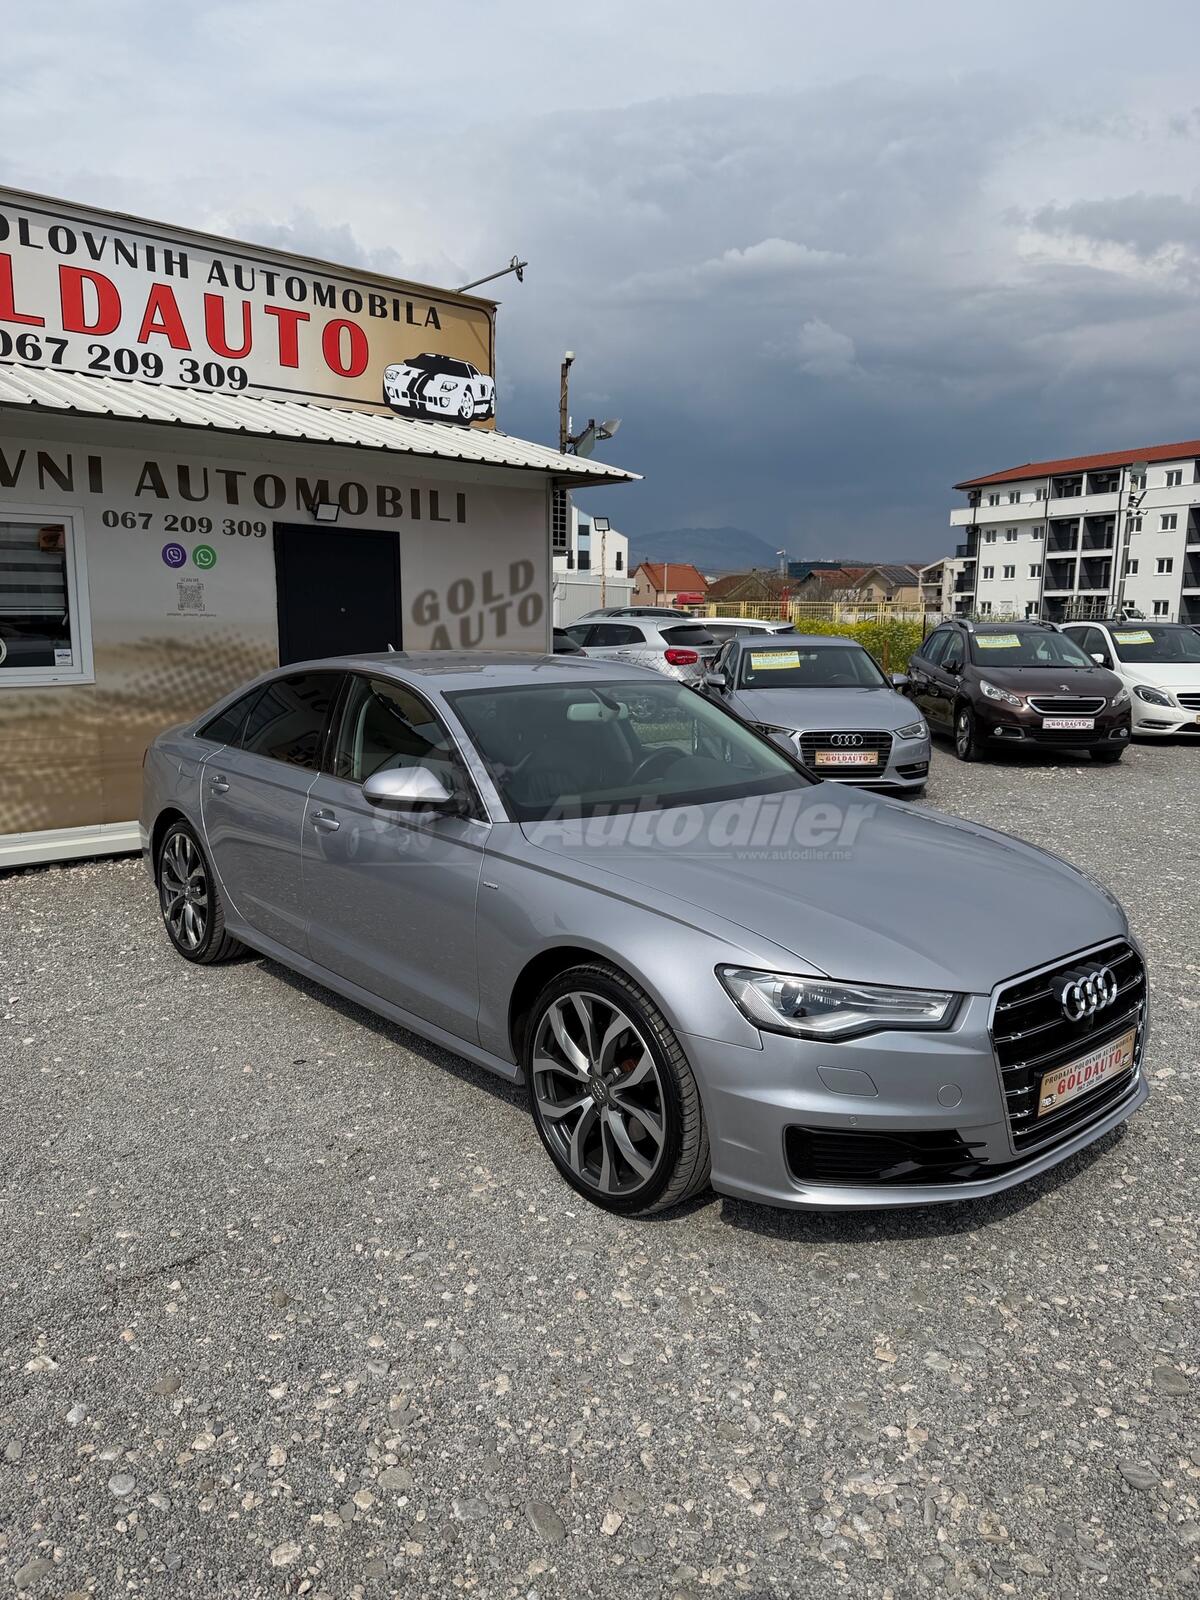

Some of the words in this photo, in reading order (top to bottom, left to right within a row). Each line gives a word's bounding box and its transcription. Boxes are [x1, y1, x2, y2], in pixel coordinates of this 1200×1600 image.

[207, 259, 441, 330] AUTOMOBILA
[88, 344, 164, 379] 209
[179, 358, 249, 391] 309
[134, 461, 466, 523] AUTOMOBILI
[102, 510, 153, 530] 067
[164, 514, 213, 534] 209
[222, 518, 267, 538] 309
[412, 559, 535, 627] GOLD
[429, 591, 544, 650] AUTO
[1057, 1049, 1121, 1095] GOLDAUTO
